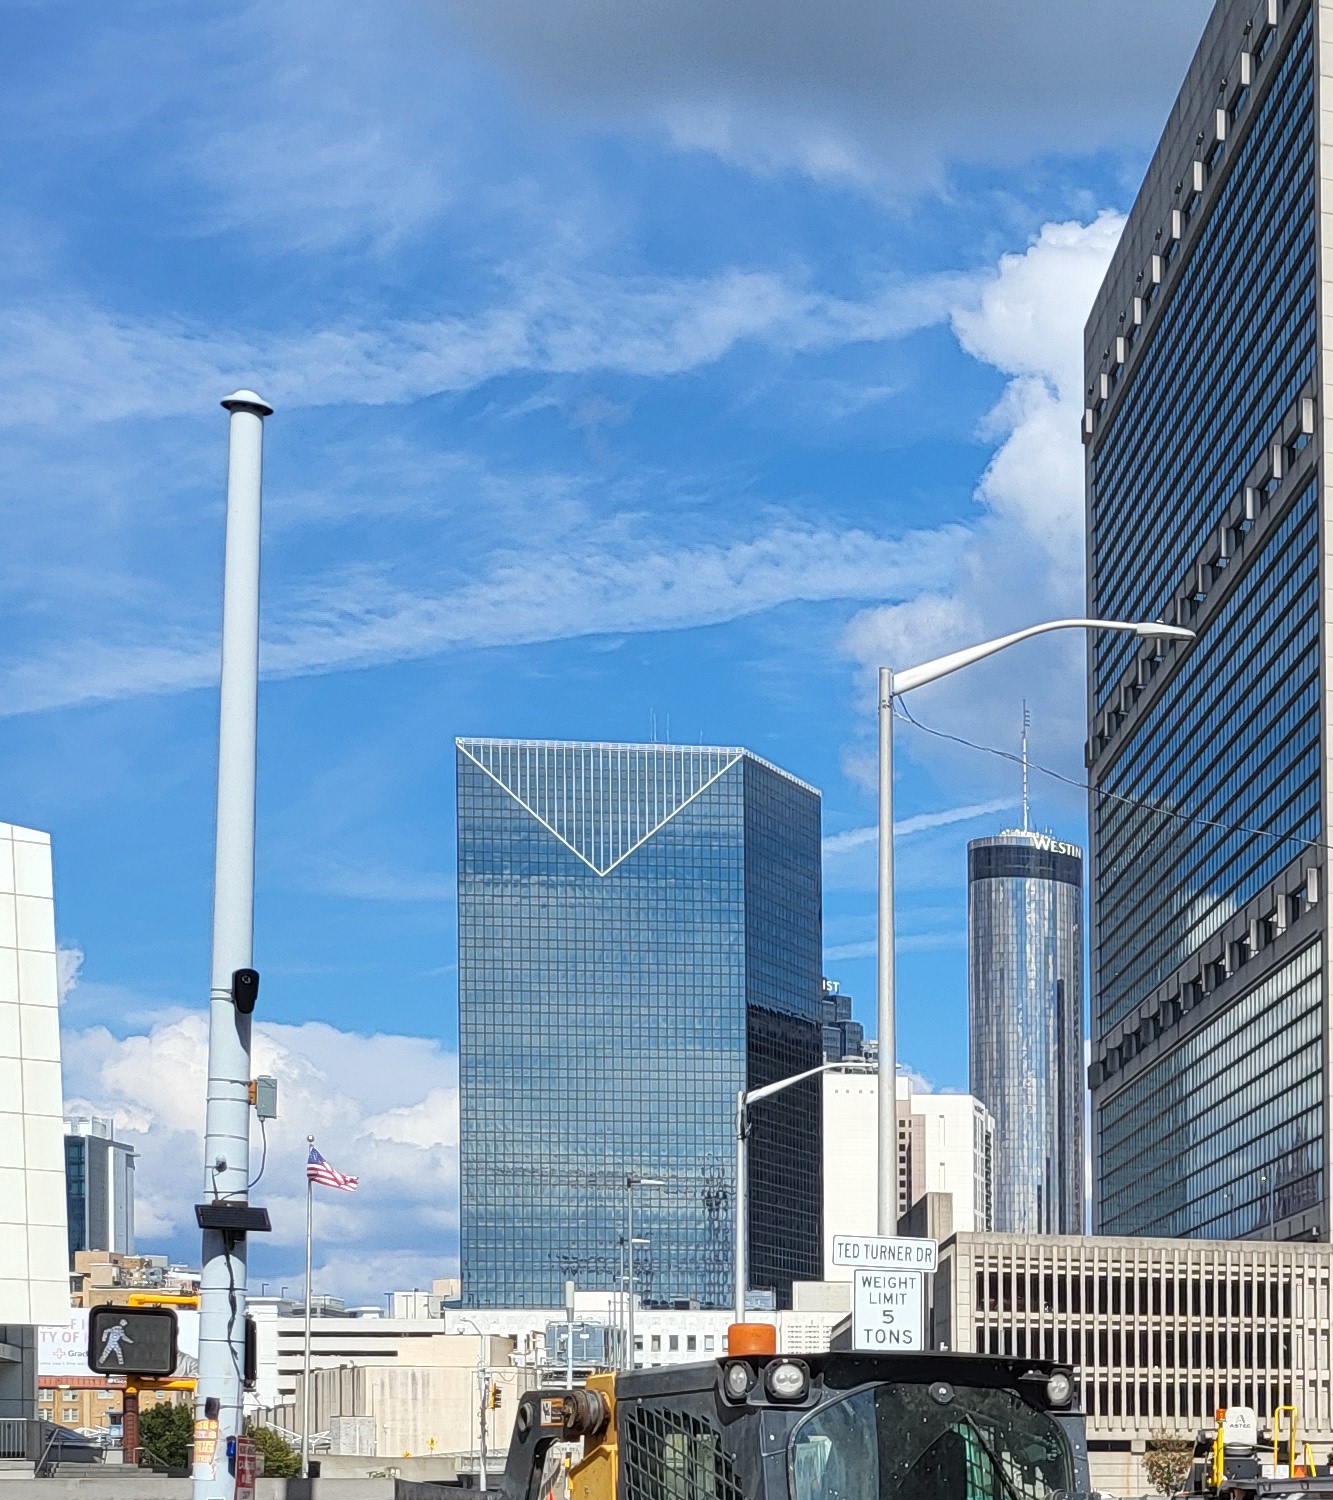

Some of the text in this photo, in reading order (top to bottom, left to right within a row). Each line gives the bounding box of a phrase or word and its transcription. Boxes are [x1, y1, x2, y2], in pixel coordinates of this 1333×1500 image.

[1033, 836, 1082, 859] WESTIN
[822, 979, 840, 992] IST
[838, 1243, 932, 1263] TED TURNER DR
[862, 1276, 916, 1289] WEIGHT
[869, 1292, 907, 1305] LIMIT
[882, 1310, 894, 1324] 5
[864, 1329, 913, 1344] TONS
